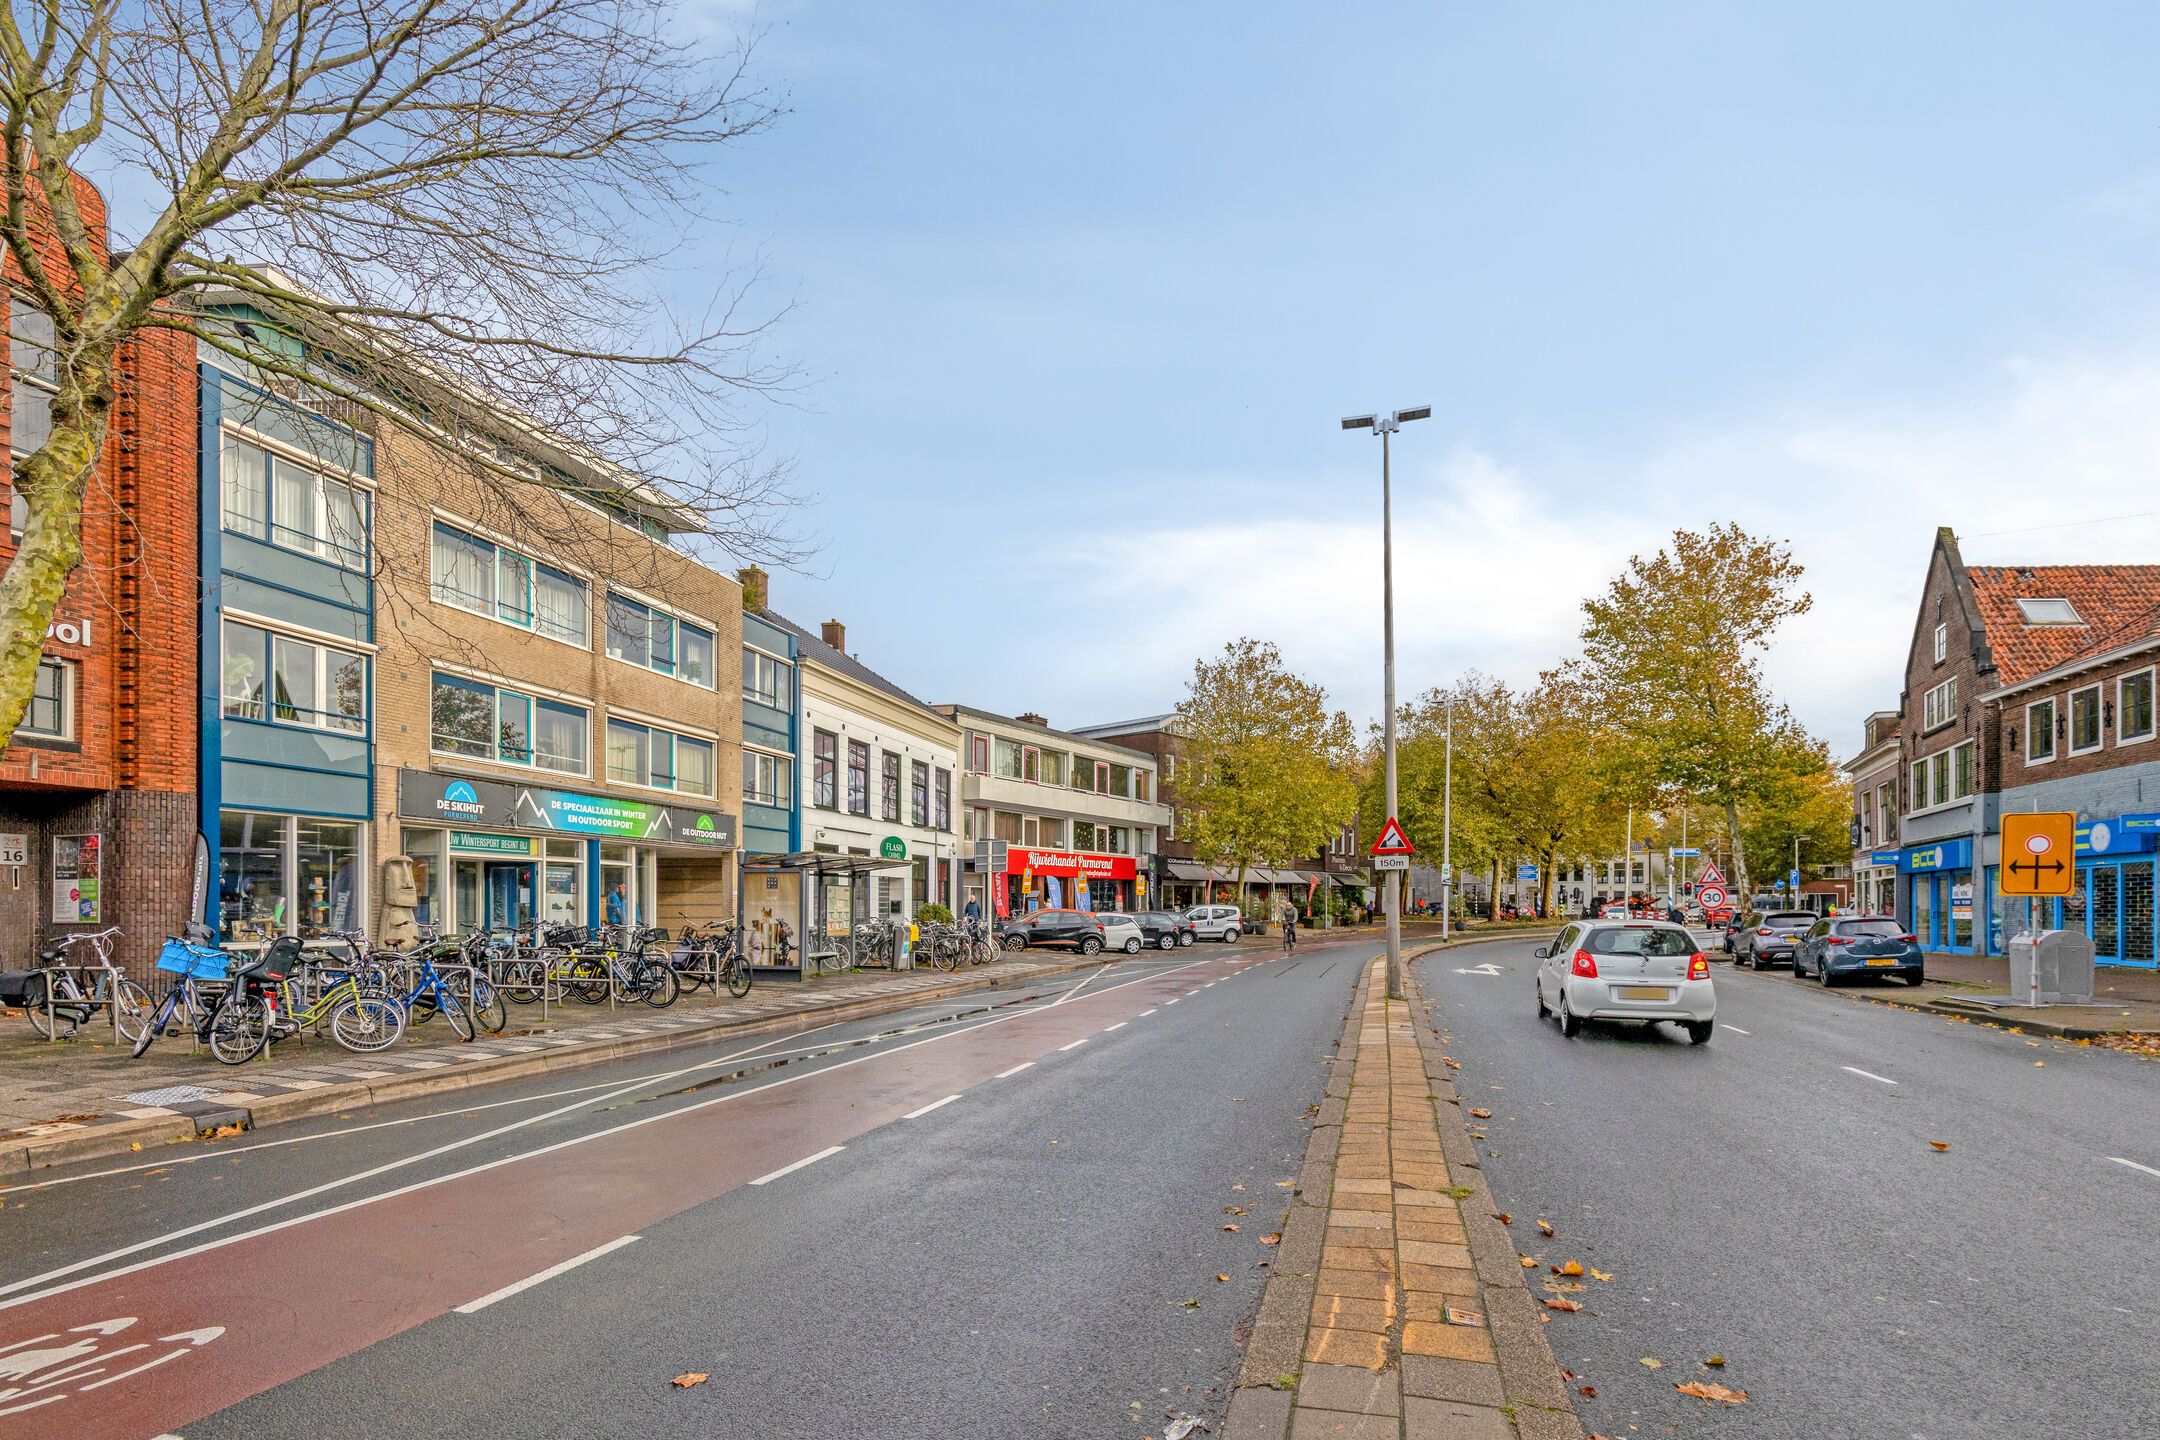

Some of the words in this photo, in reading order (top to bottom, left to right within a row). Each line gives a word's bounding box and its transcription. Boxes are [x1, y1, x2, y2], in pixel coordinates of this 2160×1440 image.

[436, 799, 449, 810] DE
[450, 801, 485, 814] SKIHUT
[551, 800, 561, 810] DE
[563, 802, 614, 816] SPECIAALZAAK
[614, 809, 621, 817] IN
[622, 809, 646, 820] WINTER
[443, 811, 478, 820] PURMEREND
[568, 814, 578, 823] EN
[682, 827, 690, 836] DE
[886, 842, 903, 852] FLASH
[3, 850, 23, 862] 16
[1028, 852, 1077, 869] Rijwielhandel
[1078, 855, 1113, 870] Purmerend
[1911, 850, 1935, 868] BCC
[1703, 893, 1721, 902] 30
